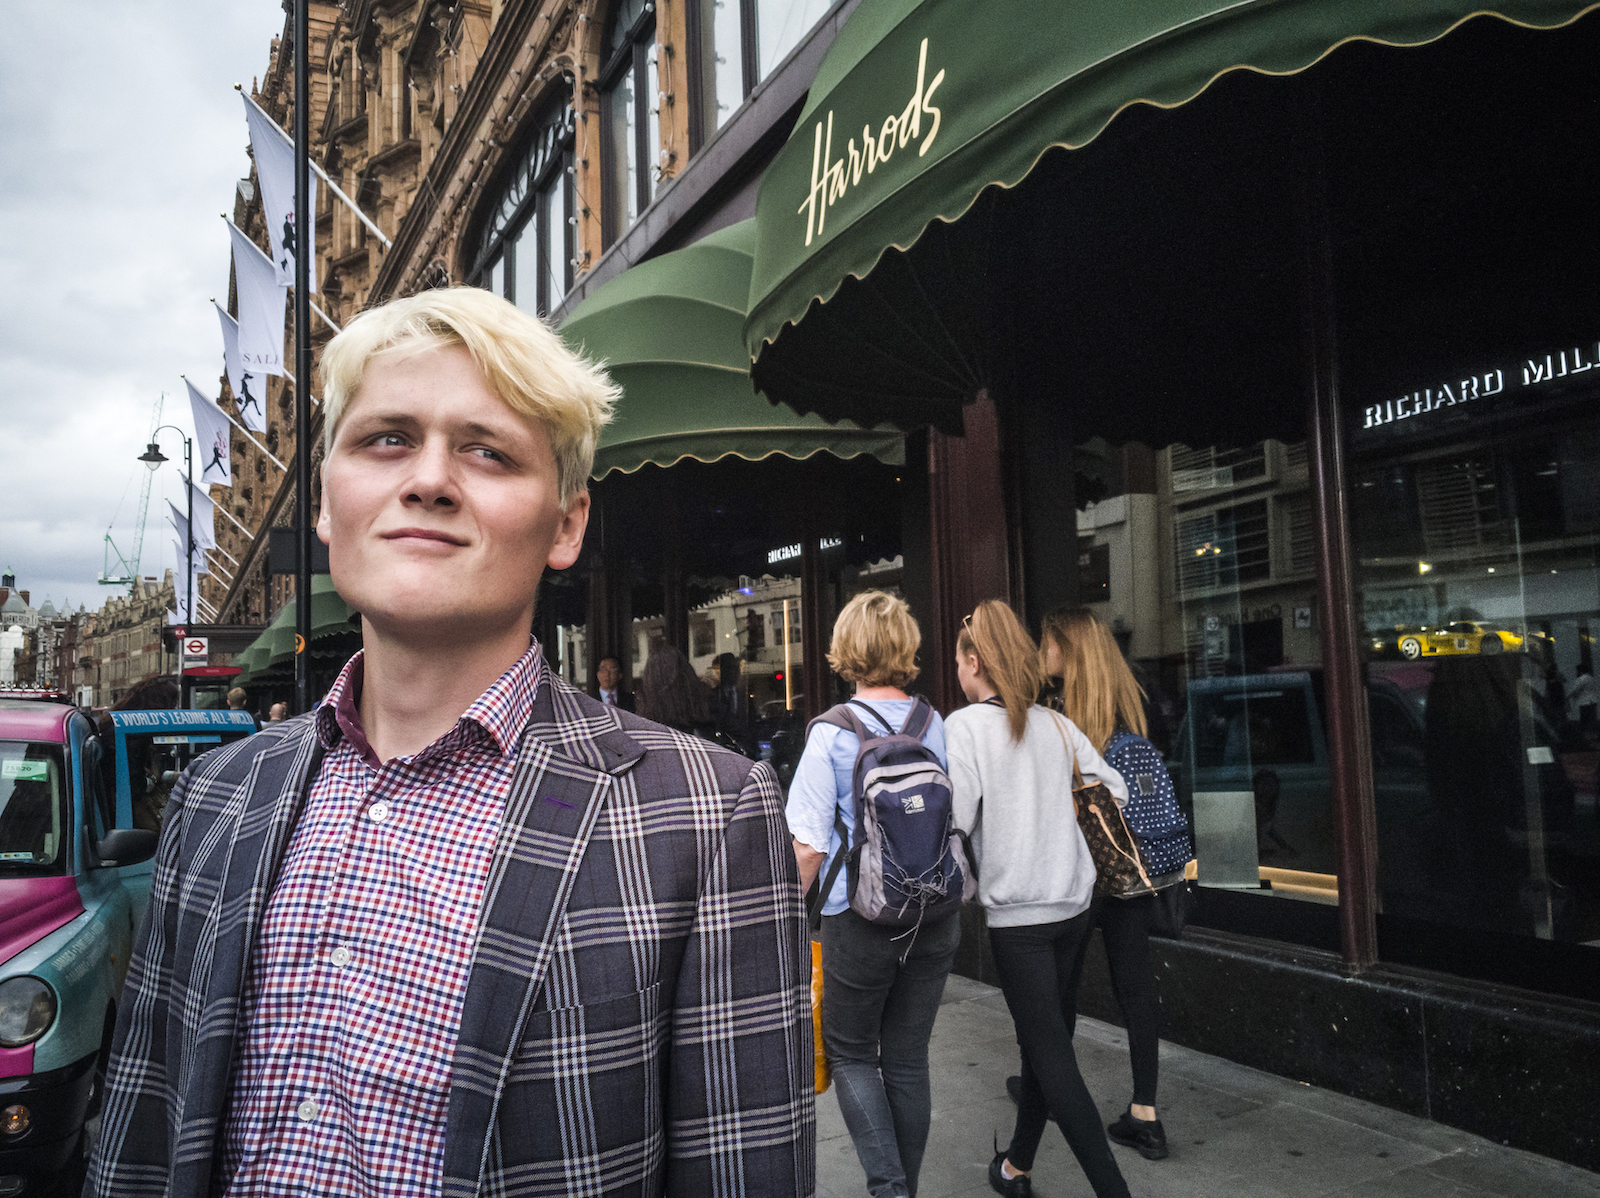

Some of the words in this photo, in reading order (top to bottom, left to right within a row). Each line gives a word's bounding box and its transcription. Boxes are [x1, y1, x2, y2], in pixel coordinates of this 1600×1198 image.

[798, 37, 945, 246] Harrods
[1362, 369, 1504, 429] RICHARD
[120, 712, 169, 726] WORLD'S
[169, 711, 210, 725] LEADING
